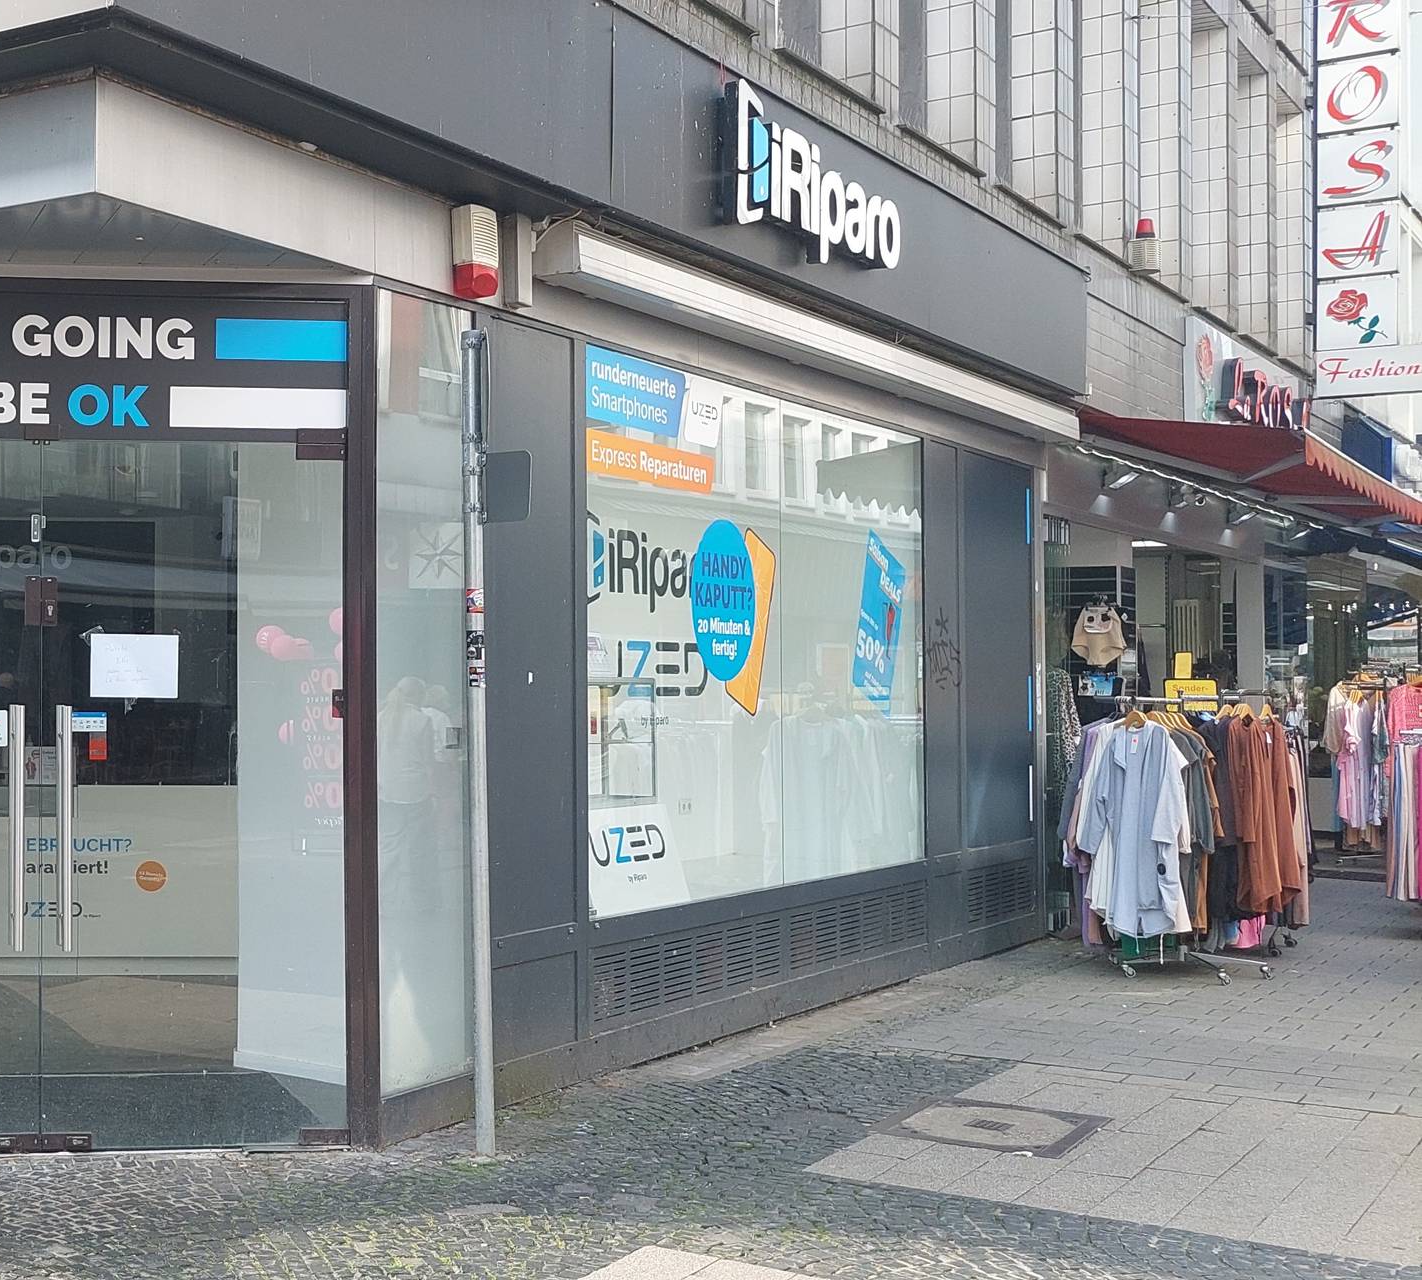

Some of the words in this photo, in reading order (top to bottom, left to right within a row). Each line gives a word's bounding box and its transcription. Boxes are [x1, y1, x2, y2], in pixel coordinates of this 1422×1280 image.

[770, 121, 901, 269] iRiparo
[12, 315, 196, 361] GOING
[591, 360, 677, 400] runderneuerte
[1319, 357, 1422, 384] Fashion
[68, 384, 149, 428] OK
[591, 386, 667, 425] Smartphones
[591, 440, 637, 470] Express
[639, 451, 708, 485] Reparaturen
[608, 528, 692, 613] iRipa
[701, 552, 748, 579] HANDY
[695, 583, 753, 612] KAPUTT?
[880, 572, 902, 604] DEALS
[697, 620, 709, 634] 20
[709, 618, 743, 636] Minuten
[743, 622, 751, 636] &
[711, 640, 738, 660] fertig!
[856, 628, 885, 675] 50%
[27, 838, 132, 852] EBRUCHT?
[589, 824, 666, 867] UZED
